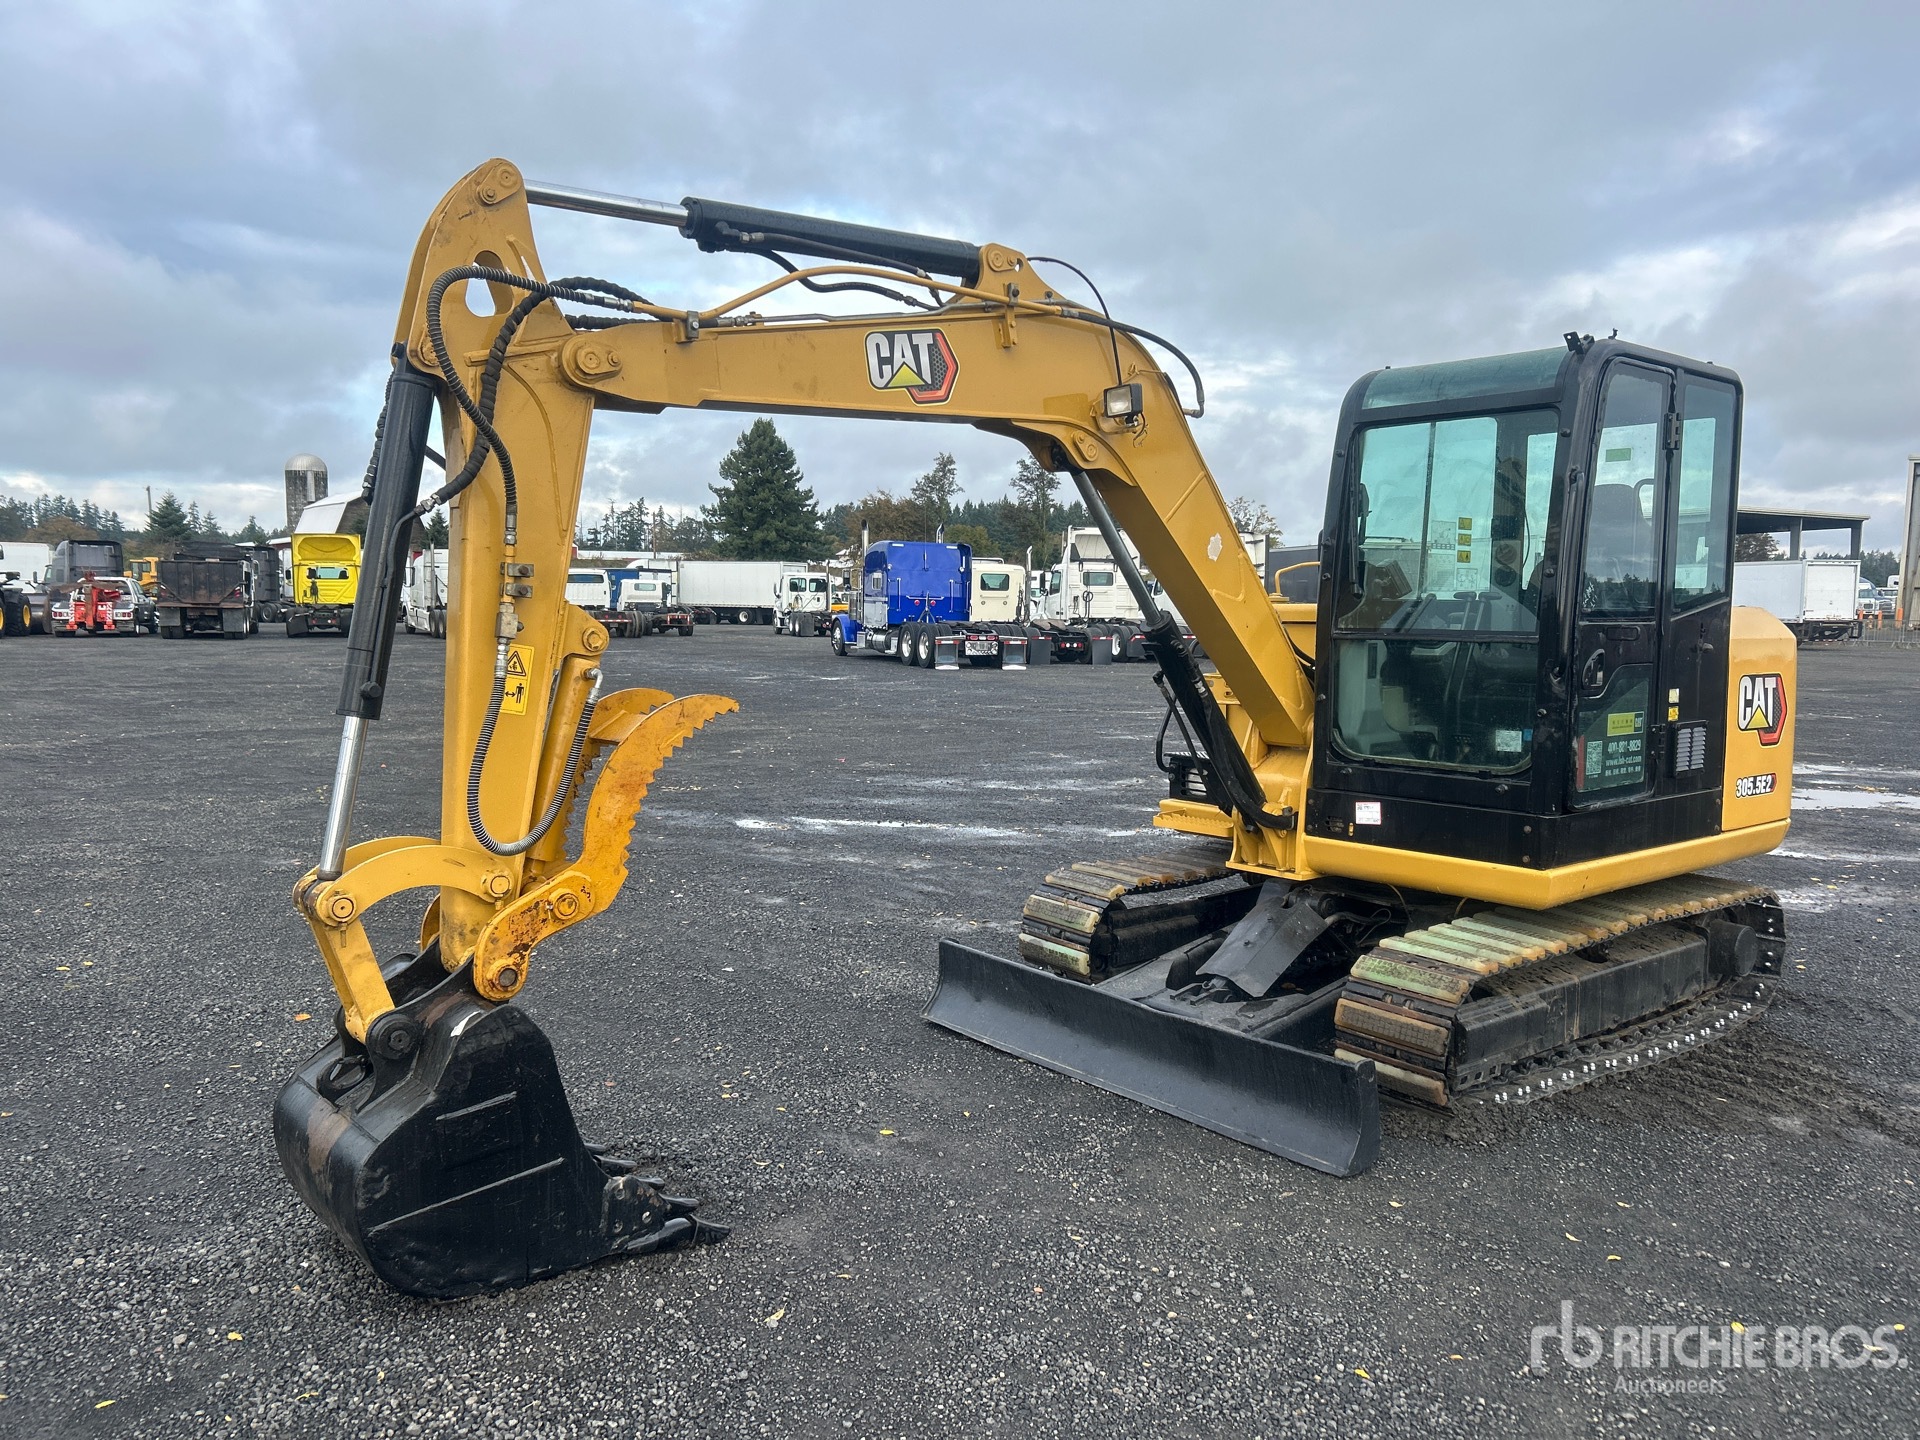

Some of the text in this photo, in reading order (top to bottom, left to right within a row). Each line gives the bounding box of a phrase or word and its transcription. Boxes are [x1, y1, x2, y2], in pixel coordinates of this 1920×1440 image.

[866, 332, 934, 388] CAT
[1738, 676, 1777, 730] CAT
[1736, 774, 1773, 798] 305.5E2
